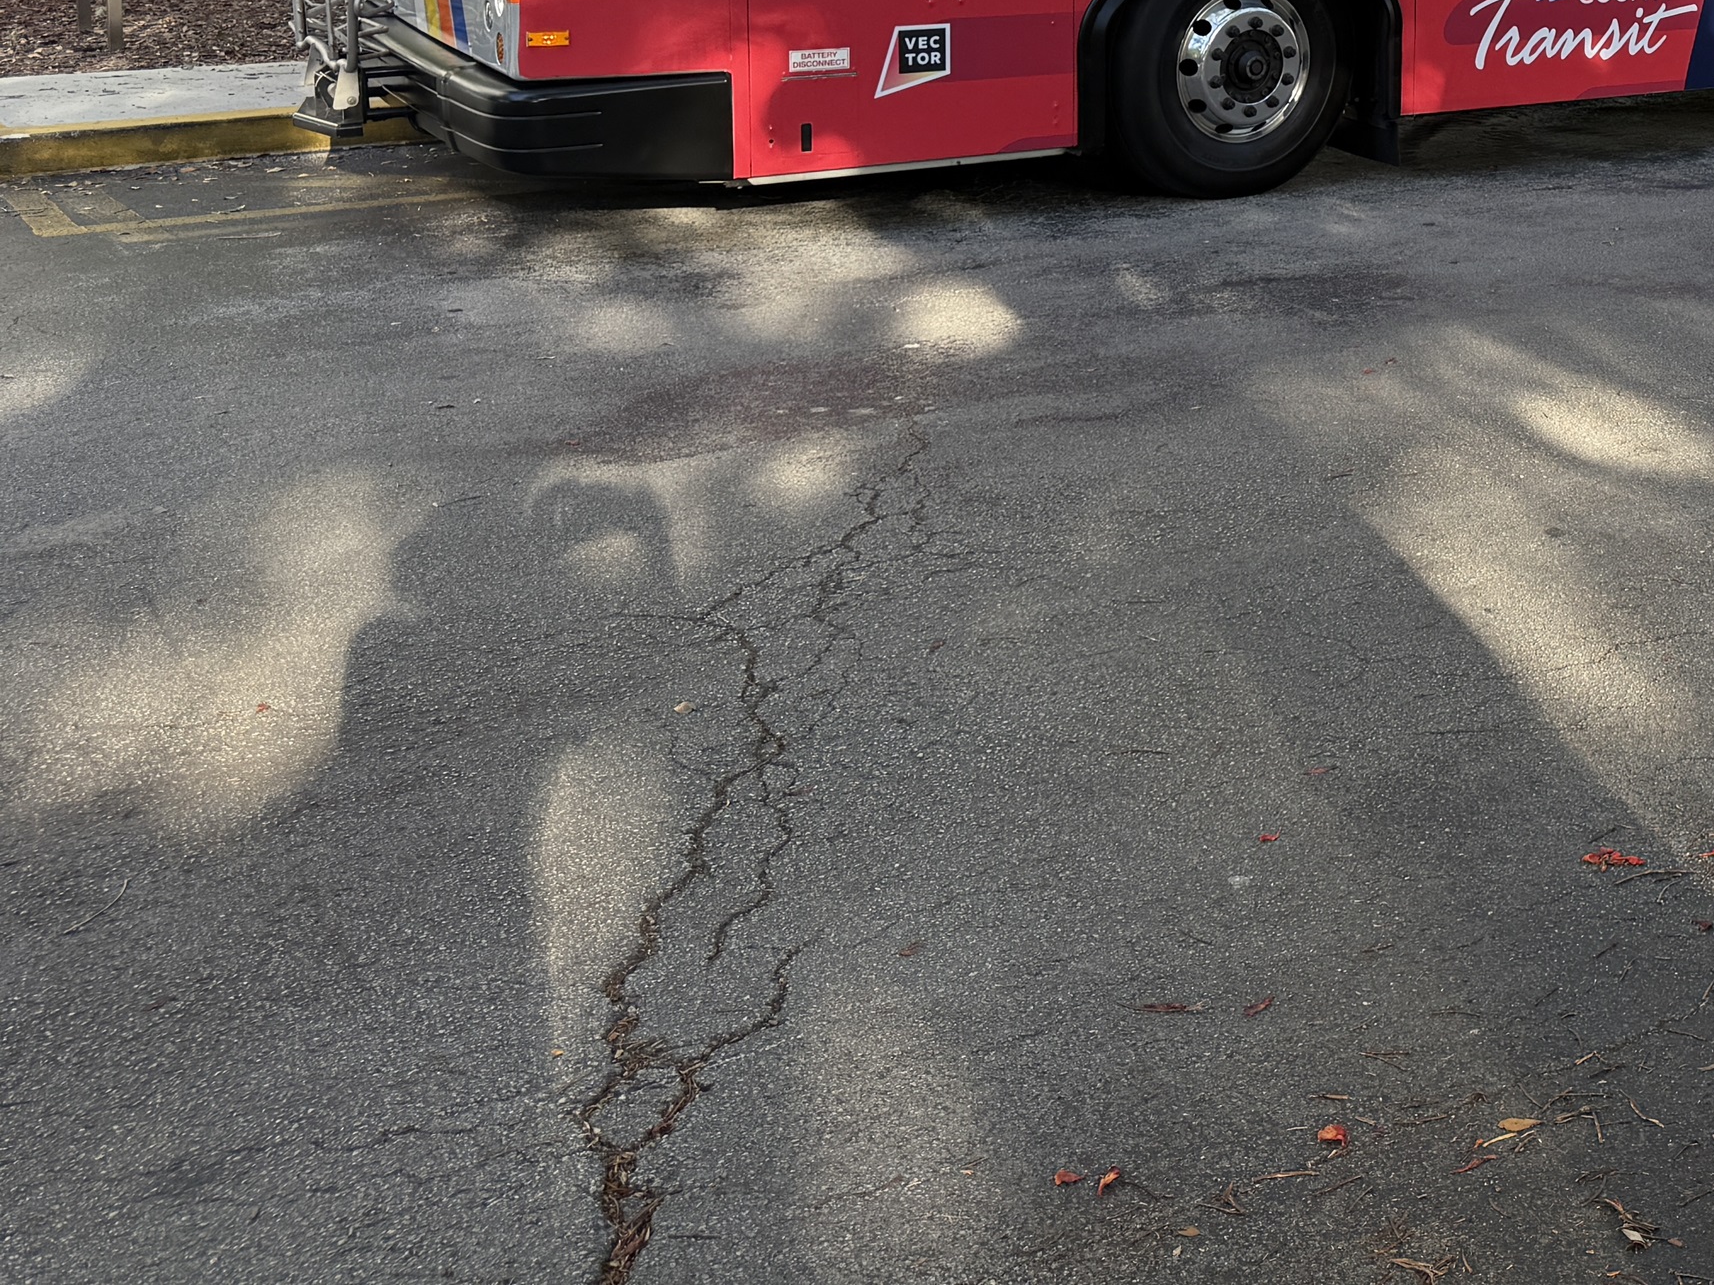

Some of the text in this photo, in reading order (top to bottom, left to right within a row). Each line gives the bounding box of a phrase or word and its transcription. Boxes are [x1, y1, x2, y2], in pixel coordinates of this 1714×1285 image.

[904, 35, 940, 50] VEC
[800, 51, 838, 60] BATTERY
[904, 51, 941, 66] TOR
[792, 58, 846, 68] DISCONNECT
